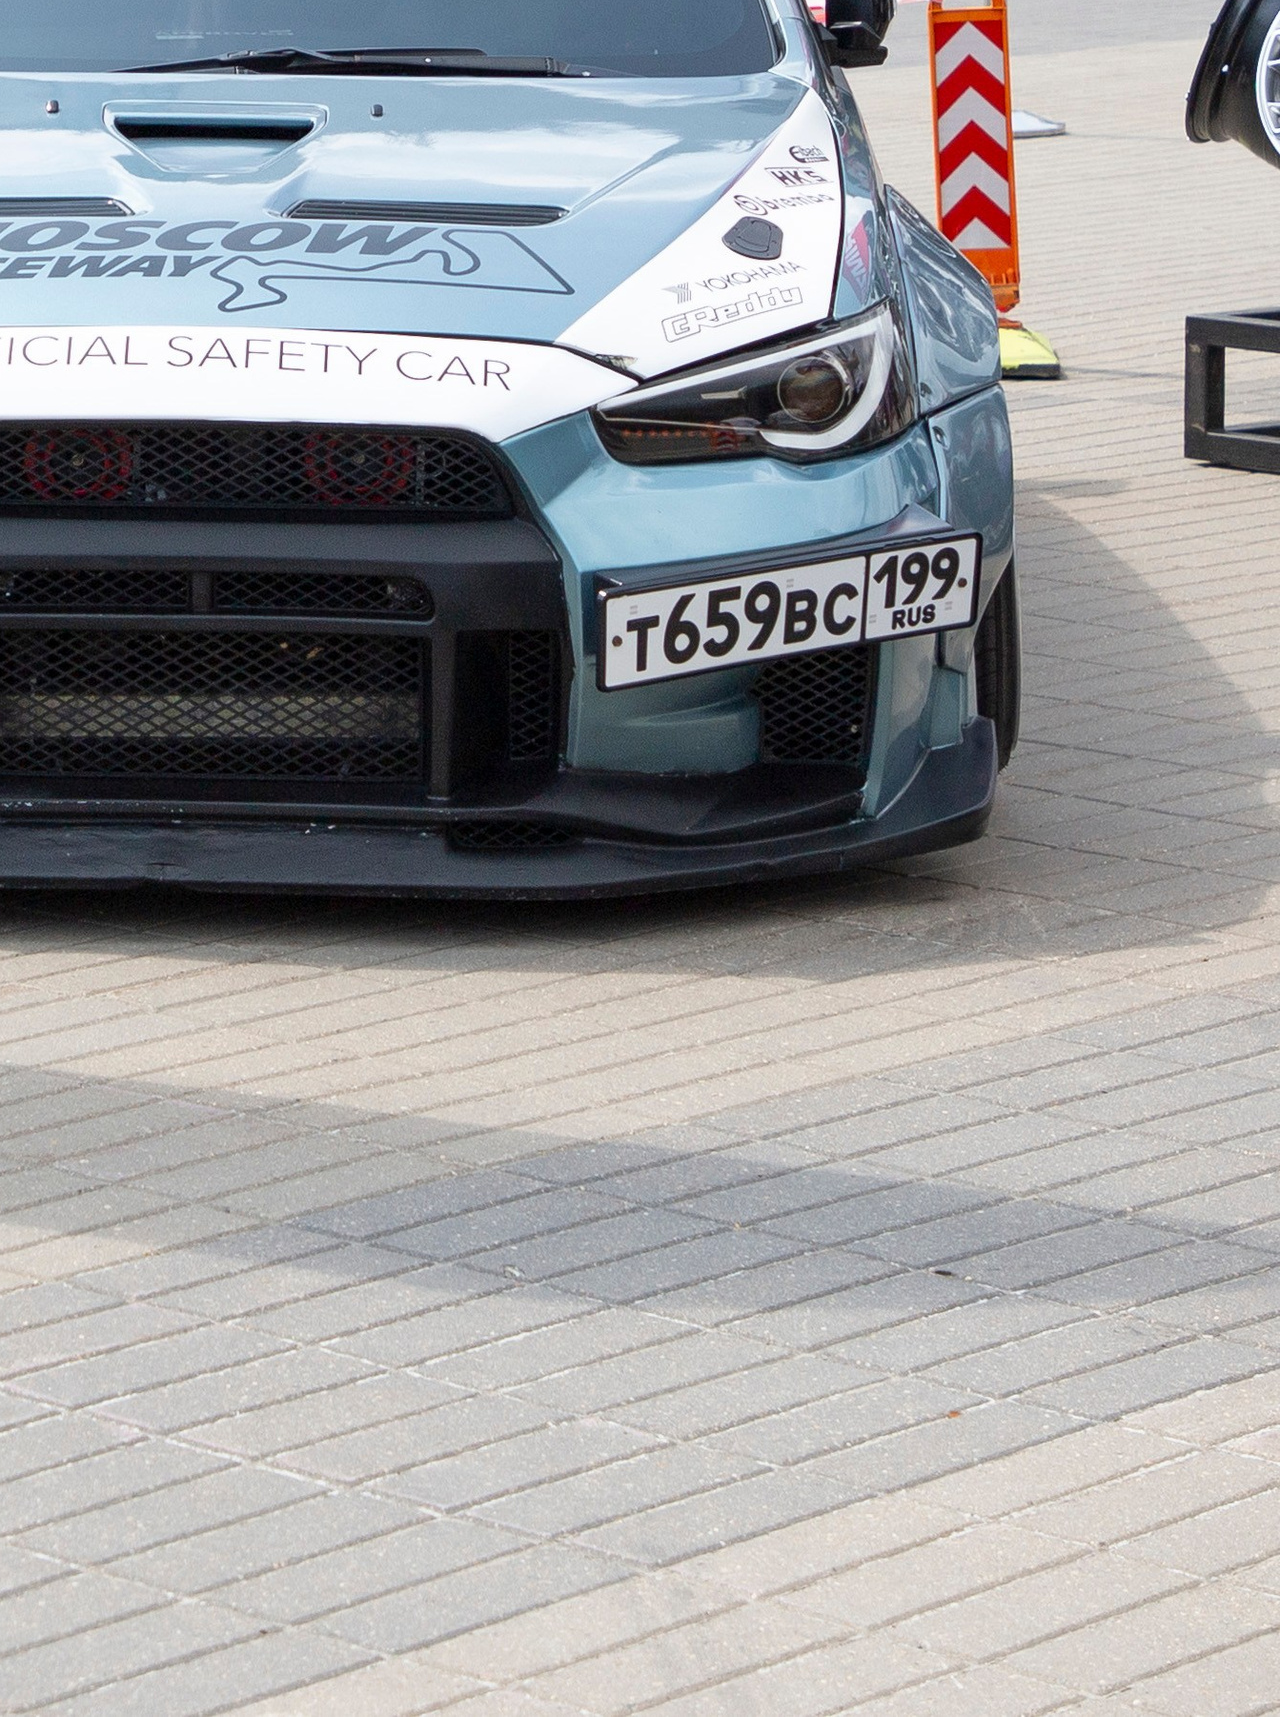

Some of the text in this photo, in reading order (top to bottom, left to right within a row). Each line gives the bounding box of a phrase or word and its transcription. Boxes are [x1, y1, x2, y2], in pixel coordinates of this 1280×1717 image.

[771, 169, 828, 186] HKS
[756, 192, 835, 210] brembo
[696, 261, 807, 292] YOKOHAMA
[165, 336, 377, 376] SAFETY
[396, 348, 512, 392] CAR
[873, 547, 960, 610] 199
[891, 603, 936, 631] RUS
